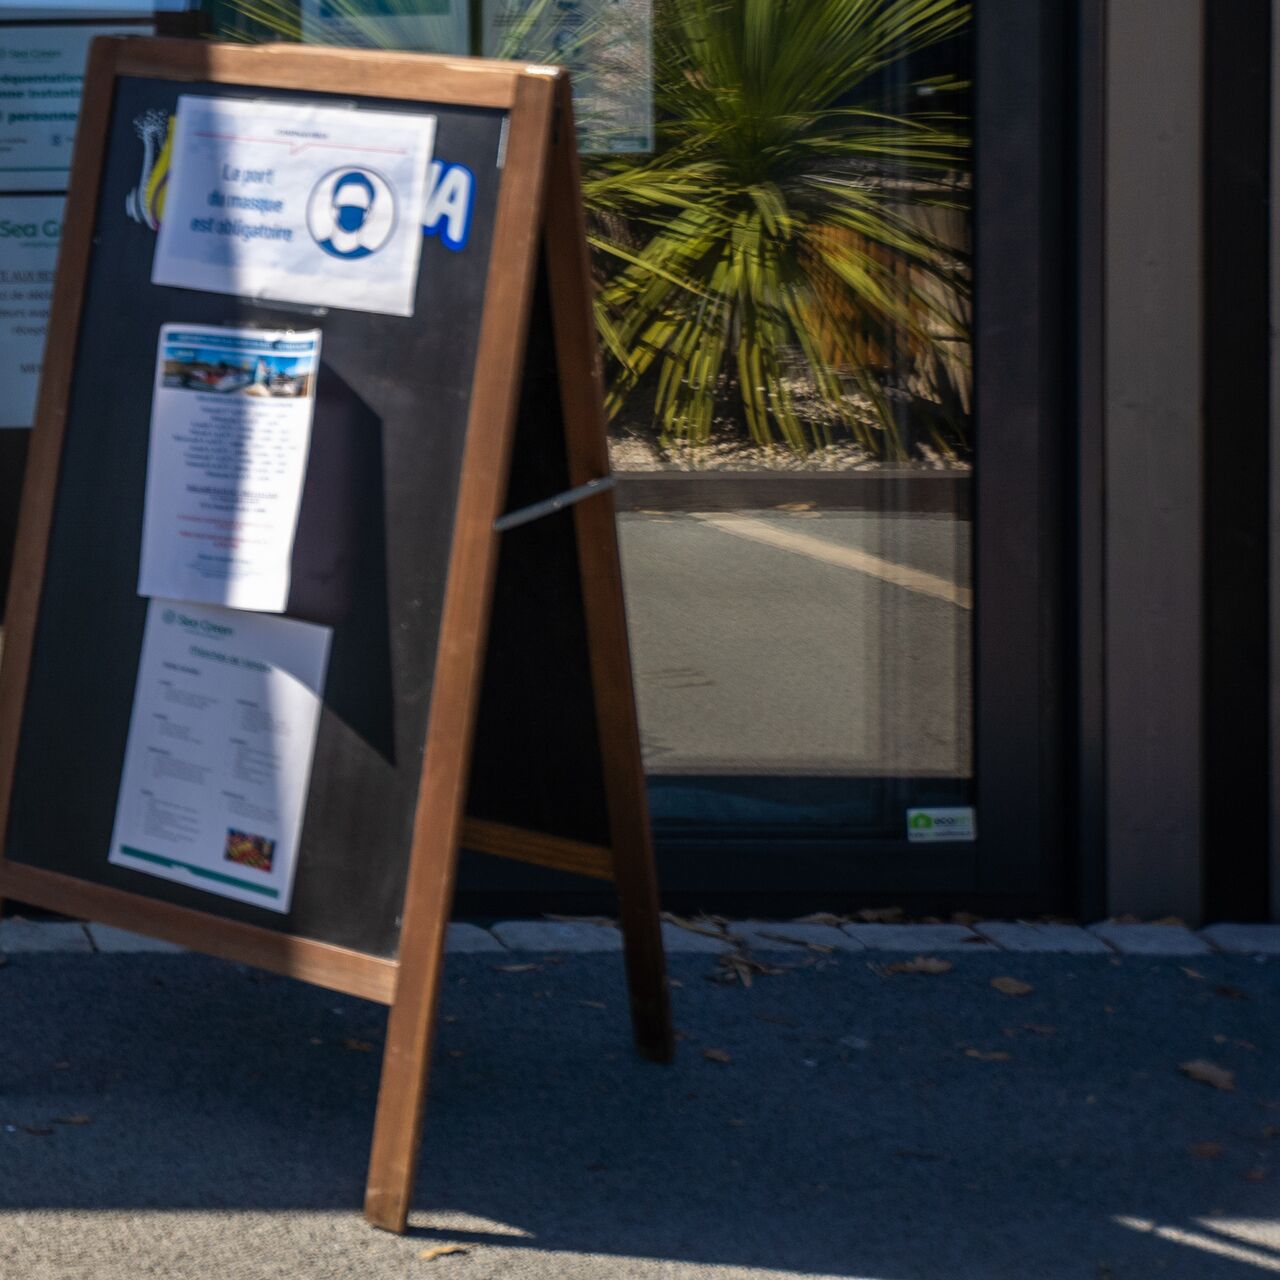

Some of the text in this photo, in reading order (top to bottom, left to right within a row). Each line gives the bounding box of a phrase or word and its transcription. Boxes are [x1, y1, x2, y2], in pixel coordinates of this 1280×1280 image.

[222, 163, 275, 185] Le port
[207, 189, 284, 215] du masque
[0, 220, 37, 238] Sea
[190, 217, 294, 244] est obligatoire
